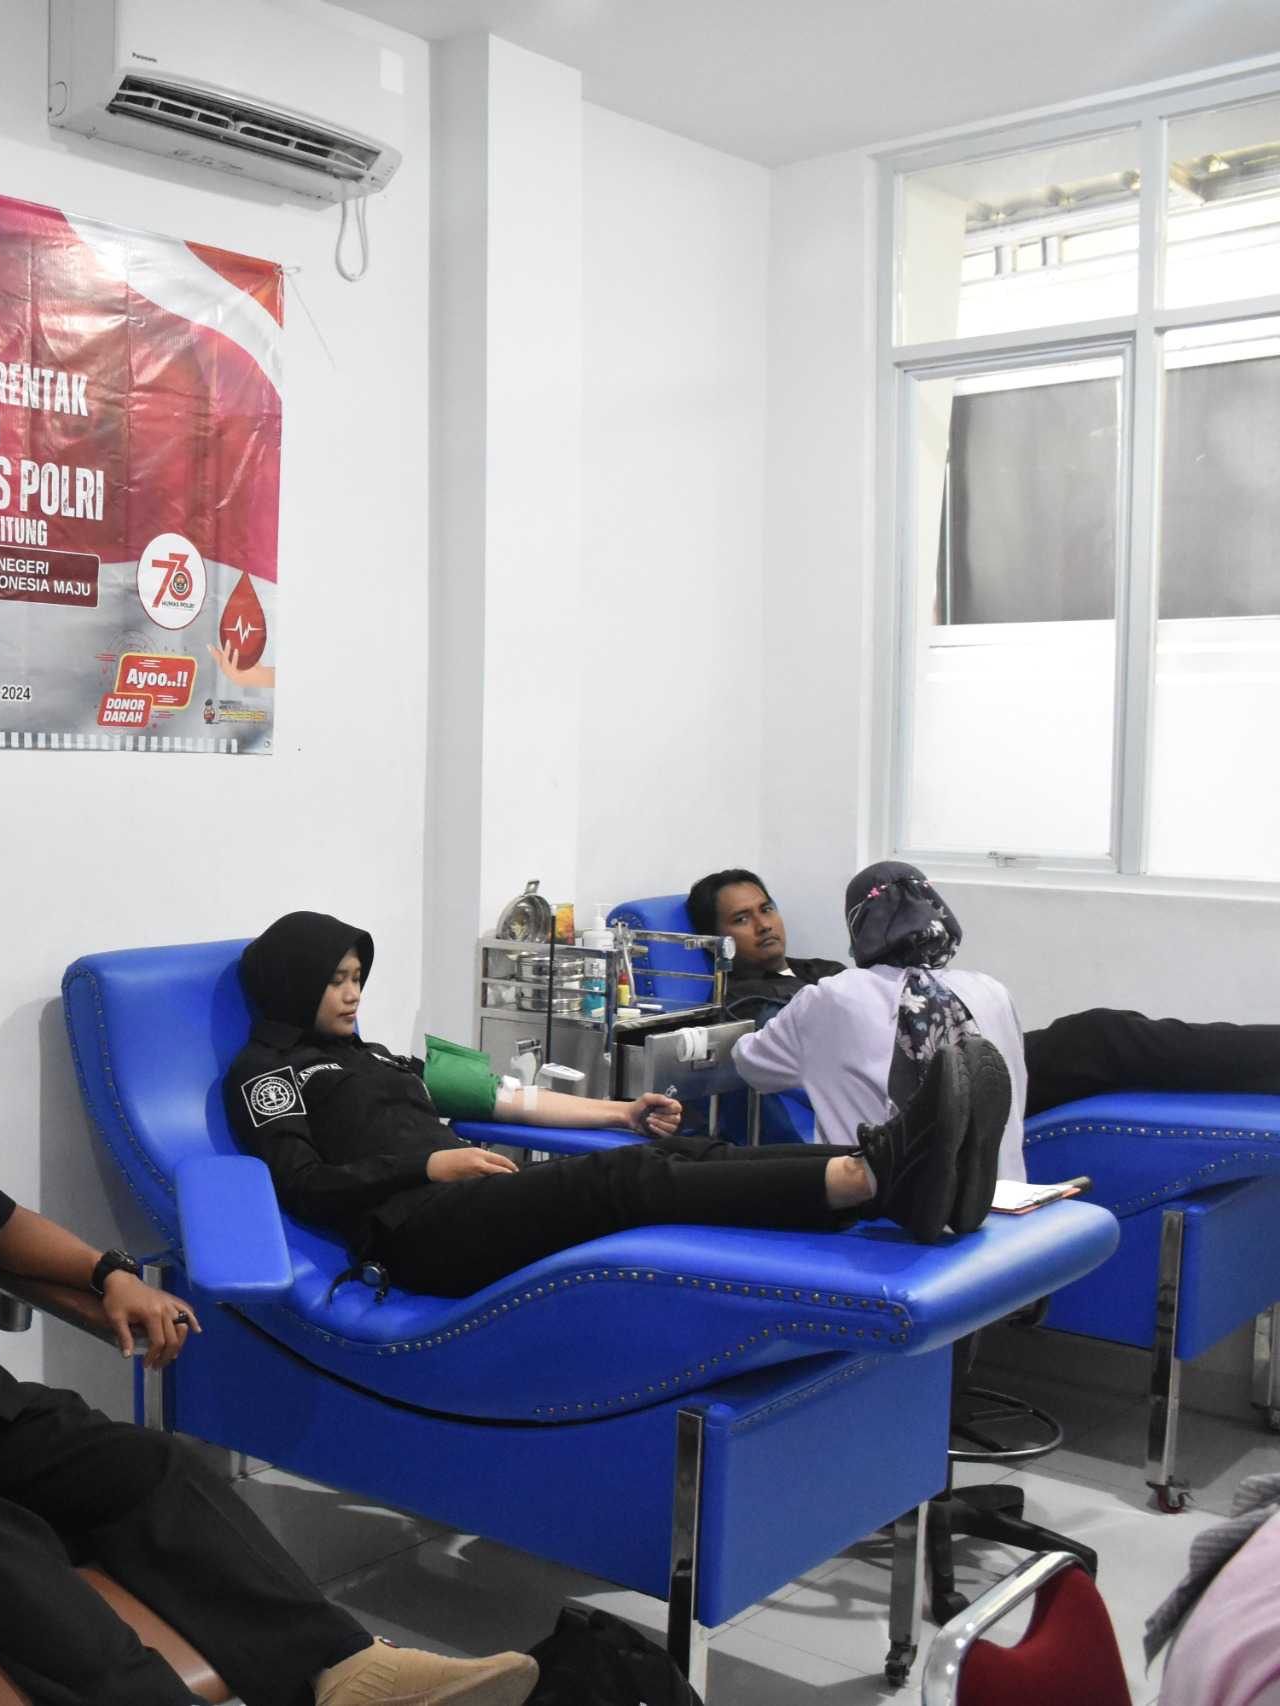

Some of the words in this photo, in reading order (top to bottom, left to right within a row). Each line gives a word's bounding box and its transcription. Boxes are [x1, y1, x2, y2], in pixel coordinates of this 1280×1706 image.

[19, 460, 104, 520] POLRI
[53, 580, 91, 596] MAJU
[126, 668, 188, 688] Ayoo..!!
[1, 685, 32, 701] 2024
[106, 698, 146, 711] DONOR
[103, 710, 144, 723] DARAH
